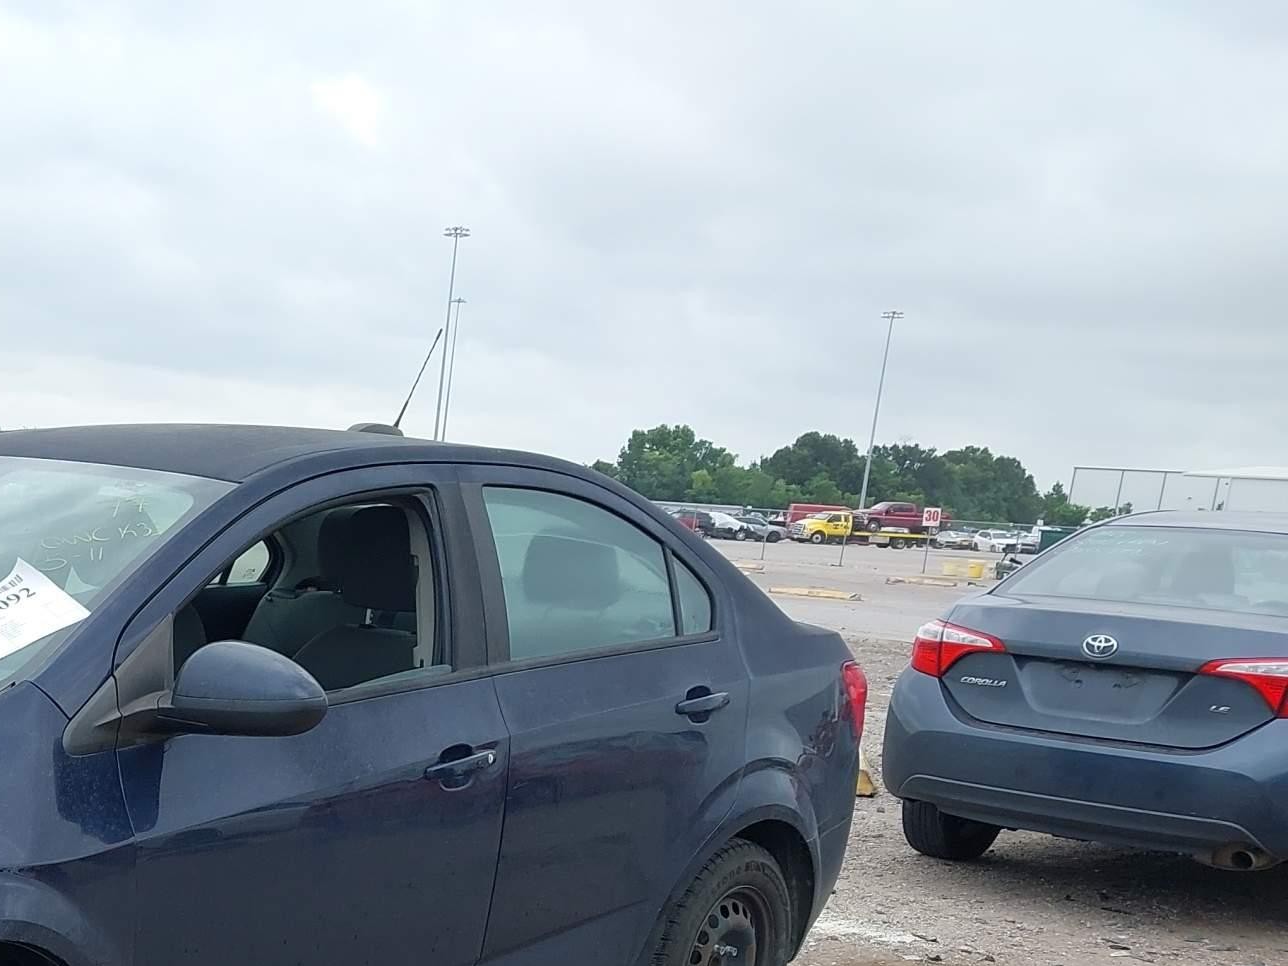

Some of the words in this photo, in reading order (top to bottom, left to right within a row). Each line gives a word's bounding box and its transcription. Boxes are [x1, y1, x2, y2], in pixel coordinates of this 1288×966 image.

[925, 510, 939, 522] 30
[960, 676, 1007, 688] COROLLA
[1209, 705, 1231, 714] LE
